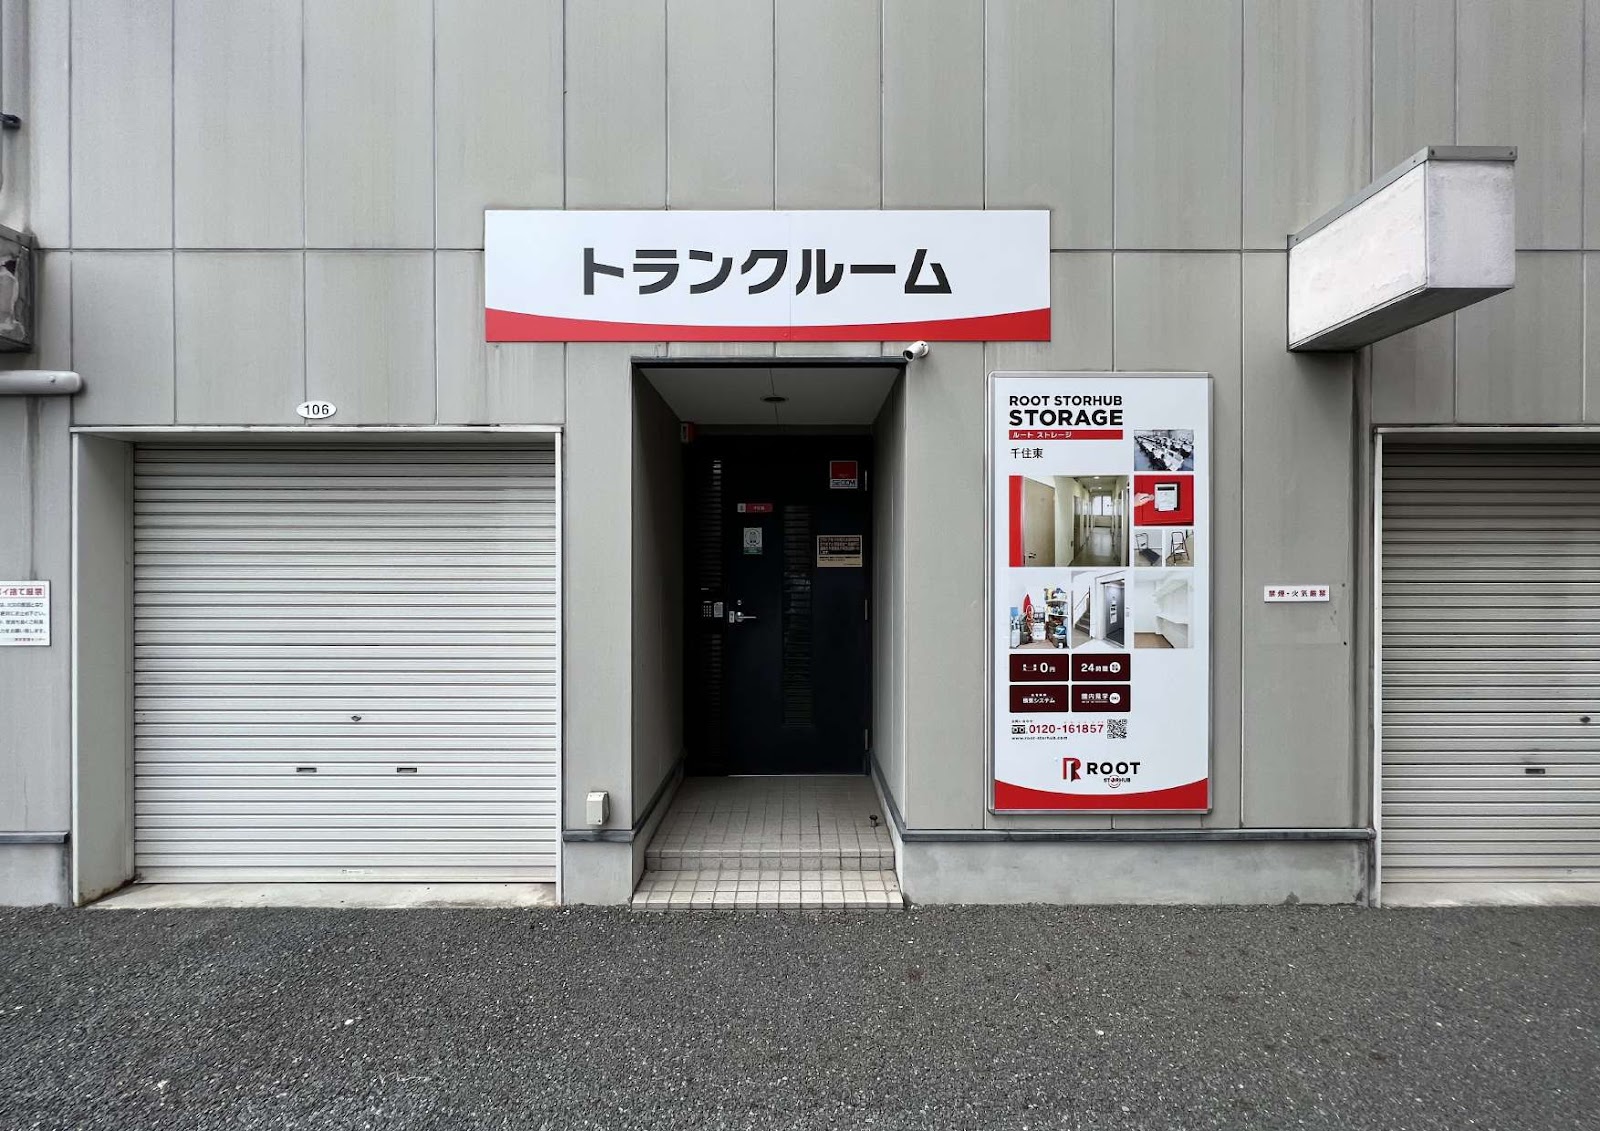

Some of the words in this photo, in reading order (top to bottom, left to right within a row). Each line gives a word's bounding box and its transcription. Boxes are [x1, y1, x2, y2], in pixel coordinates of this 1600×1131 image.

[583, 247, 953, 296] トランクルーム
[1009, 395, 1050, 406] ROOT
[1054, 395, 1123, 406] STORHUB
[304, 404, 329, 415] 106
[1009, 409, 1123, 426] STORAGE
[1013, 431, 1034, 439] ルート
[1037, 431, 1072, 439] ストレージ
[1010, 447, 1044, 459] 千住東
[0, 587, 43, 596] イ捨て厳禁
[1028, 724, 1104, 734] 0120-161857
[1086, 762, 1140, 775] ROOT
